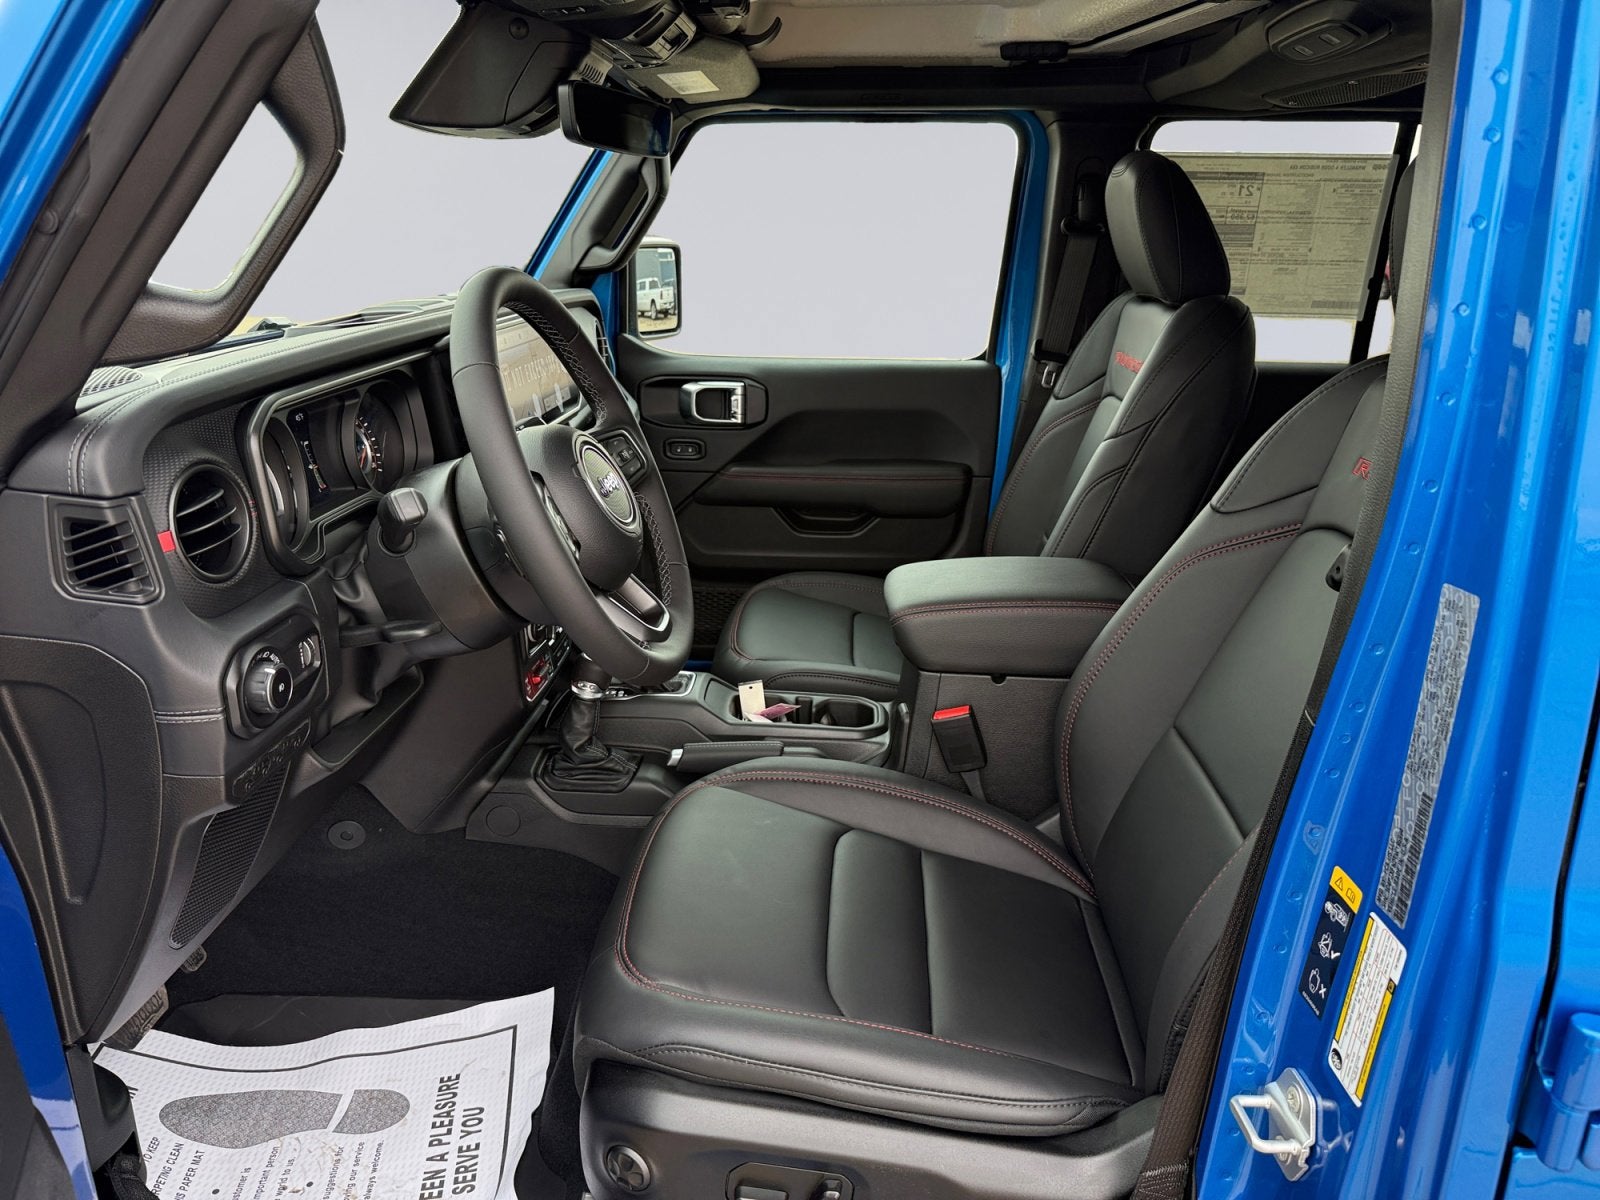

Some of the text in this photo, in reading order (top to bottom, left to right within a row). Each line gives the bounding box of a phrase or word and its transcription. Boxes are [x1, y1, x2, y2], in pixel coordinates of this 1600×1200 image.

[428, 1073, 460, 1147] PLEASURE
[146, 1136, 160, 1154] KEEP
[166, 1142, 184, 1165] CLEAN
[265, 1146, 280, 1168] person
[353, 1141, 366, 1167] service
[426, 1151, 449, 1161] A
[452, 1107, 485, 1195] SERVE YOU
[179, 1167, 198, 1192] PAPER
[190, 1150, 205, 1166] MAT
[323, 1158, 341, 1200] suggestions
[349, 1169, 358, 1181] our
[363, 1140, 384, 1200] always welcome.
